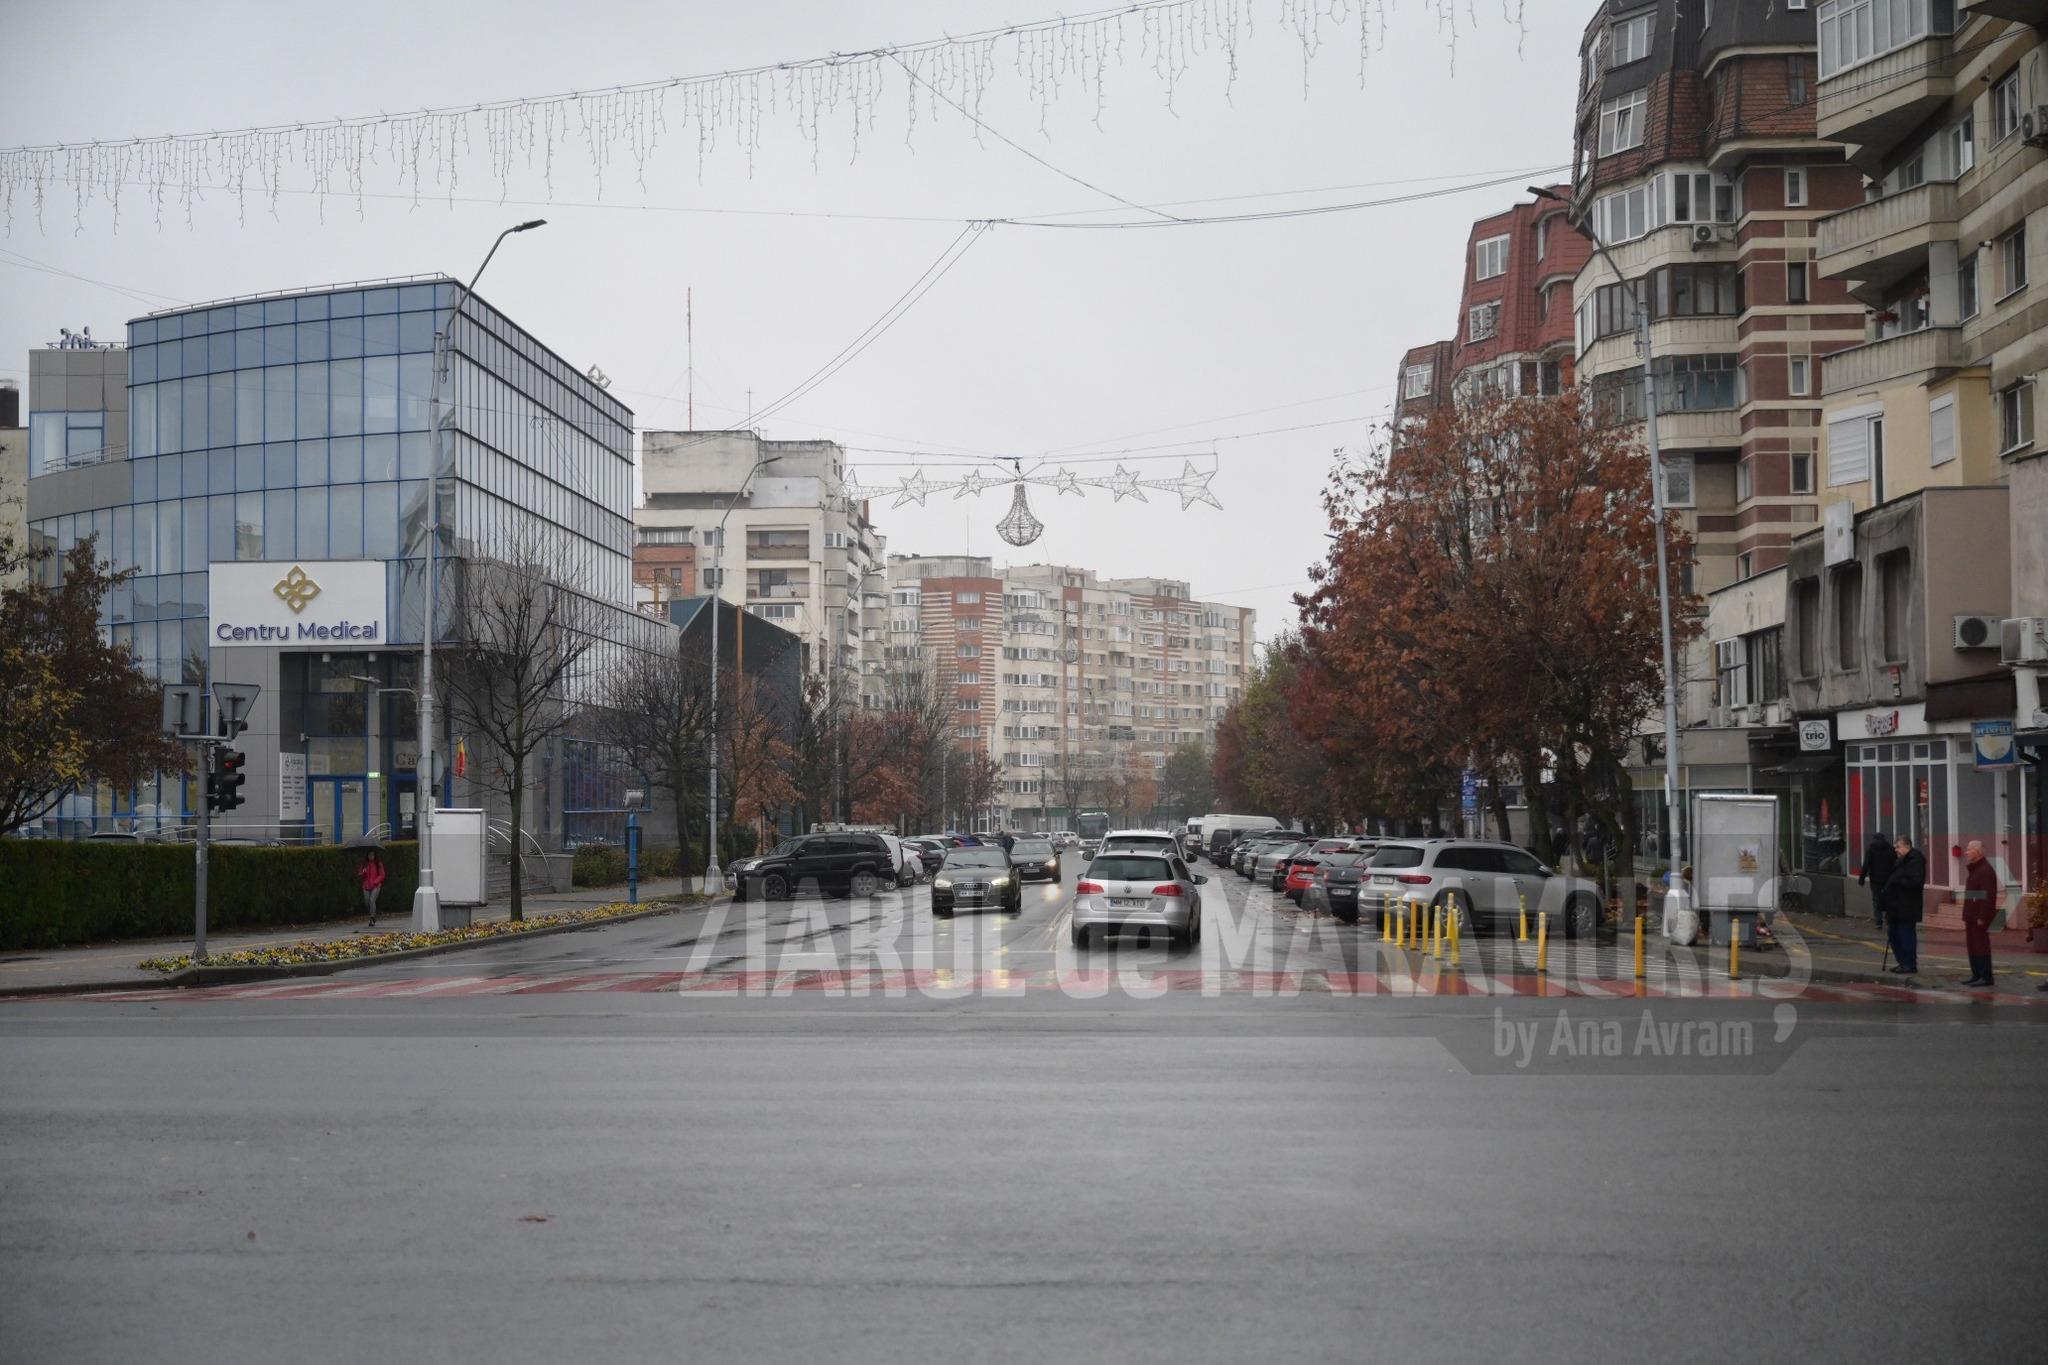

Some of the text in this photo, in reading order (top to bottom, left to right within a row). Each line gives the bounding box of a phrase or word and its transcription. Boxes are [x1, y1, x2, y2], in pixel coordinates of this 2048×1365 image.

[216, 620, 379, 641] Centru Medical
[1805, 730, 1825, 740] trio
